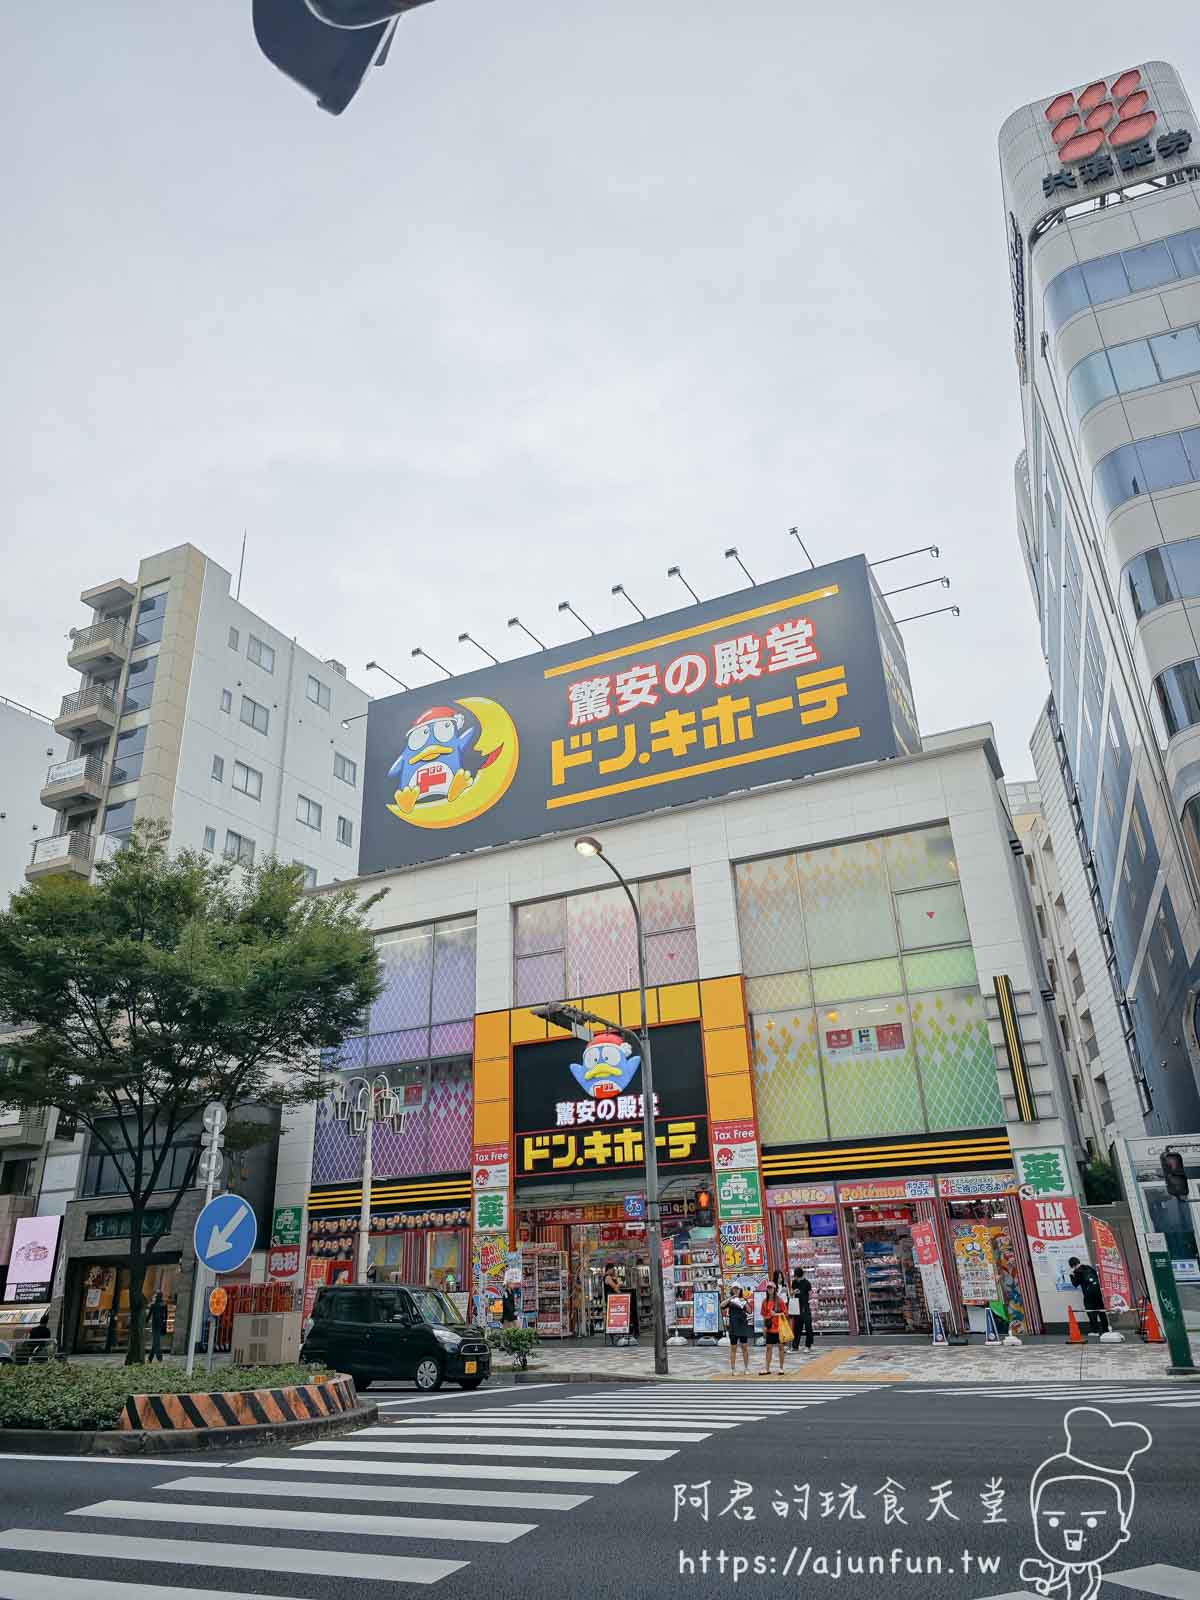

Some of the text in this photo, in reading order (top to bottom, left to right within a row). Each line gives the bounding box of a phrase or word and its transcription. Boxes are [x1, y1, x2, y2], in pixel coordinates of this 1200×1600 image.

[568, 617, 819, 727] 驚安の殿堂
[715, 1129, 755, 1141] Tax Free
[475, 1153, 489, 1162] Tax
[1036, 1202, 1066, 1219] TAX
[722, 1222, 762, 1235] TAX FREE
[1037, 1219, 1073, 1237] FREE
